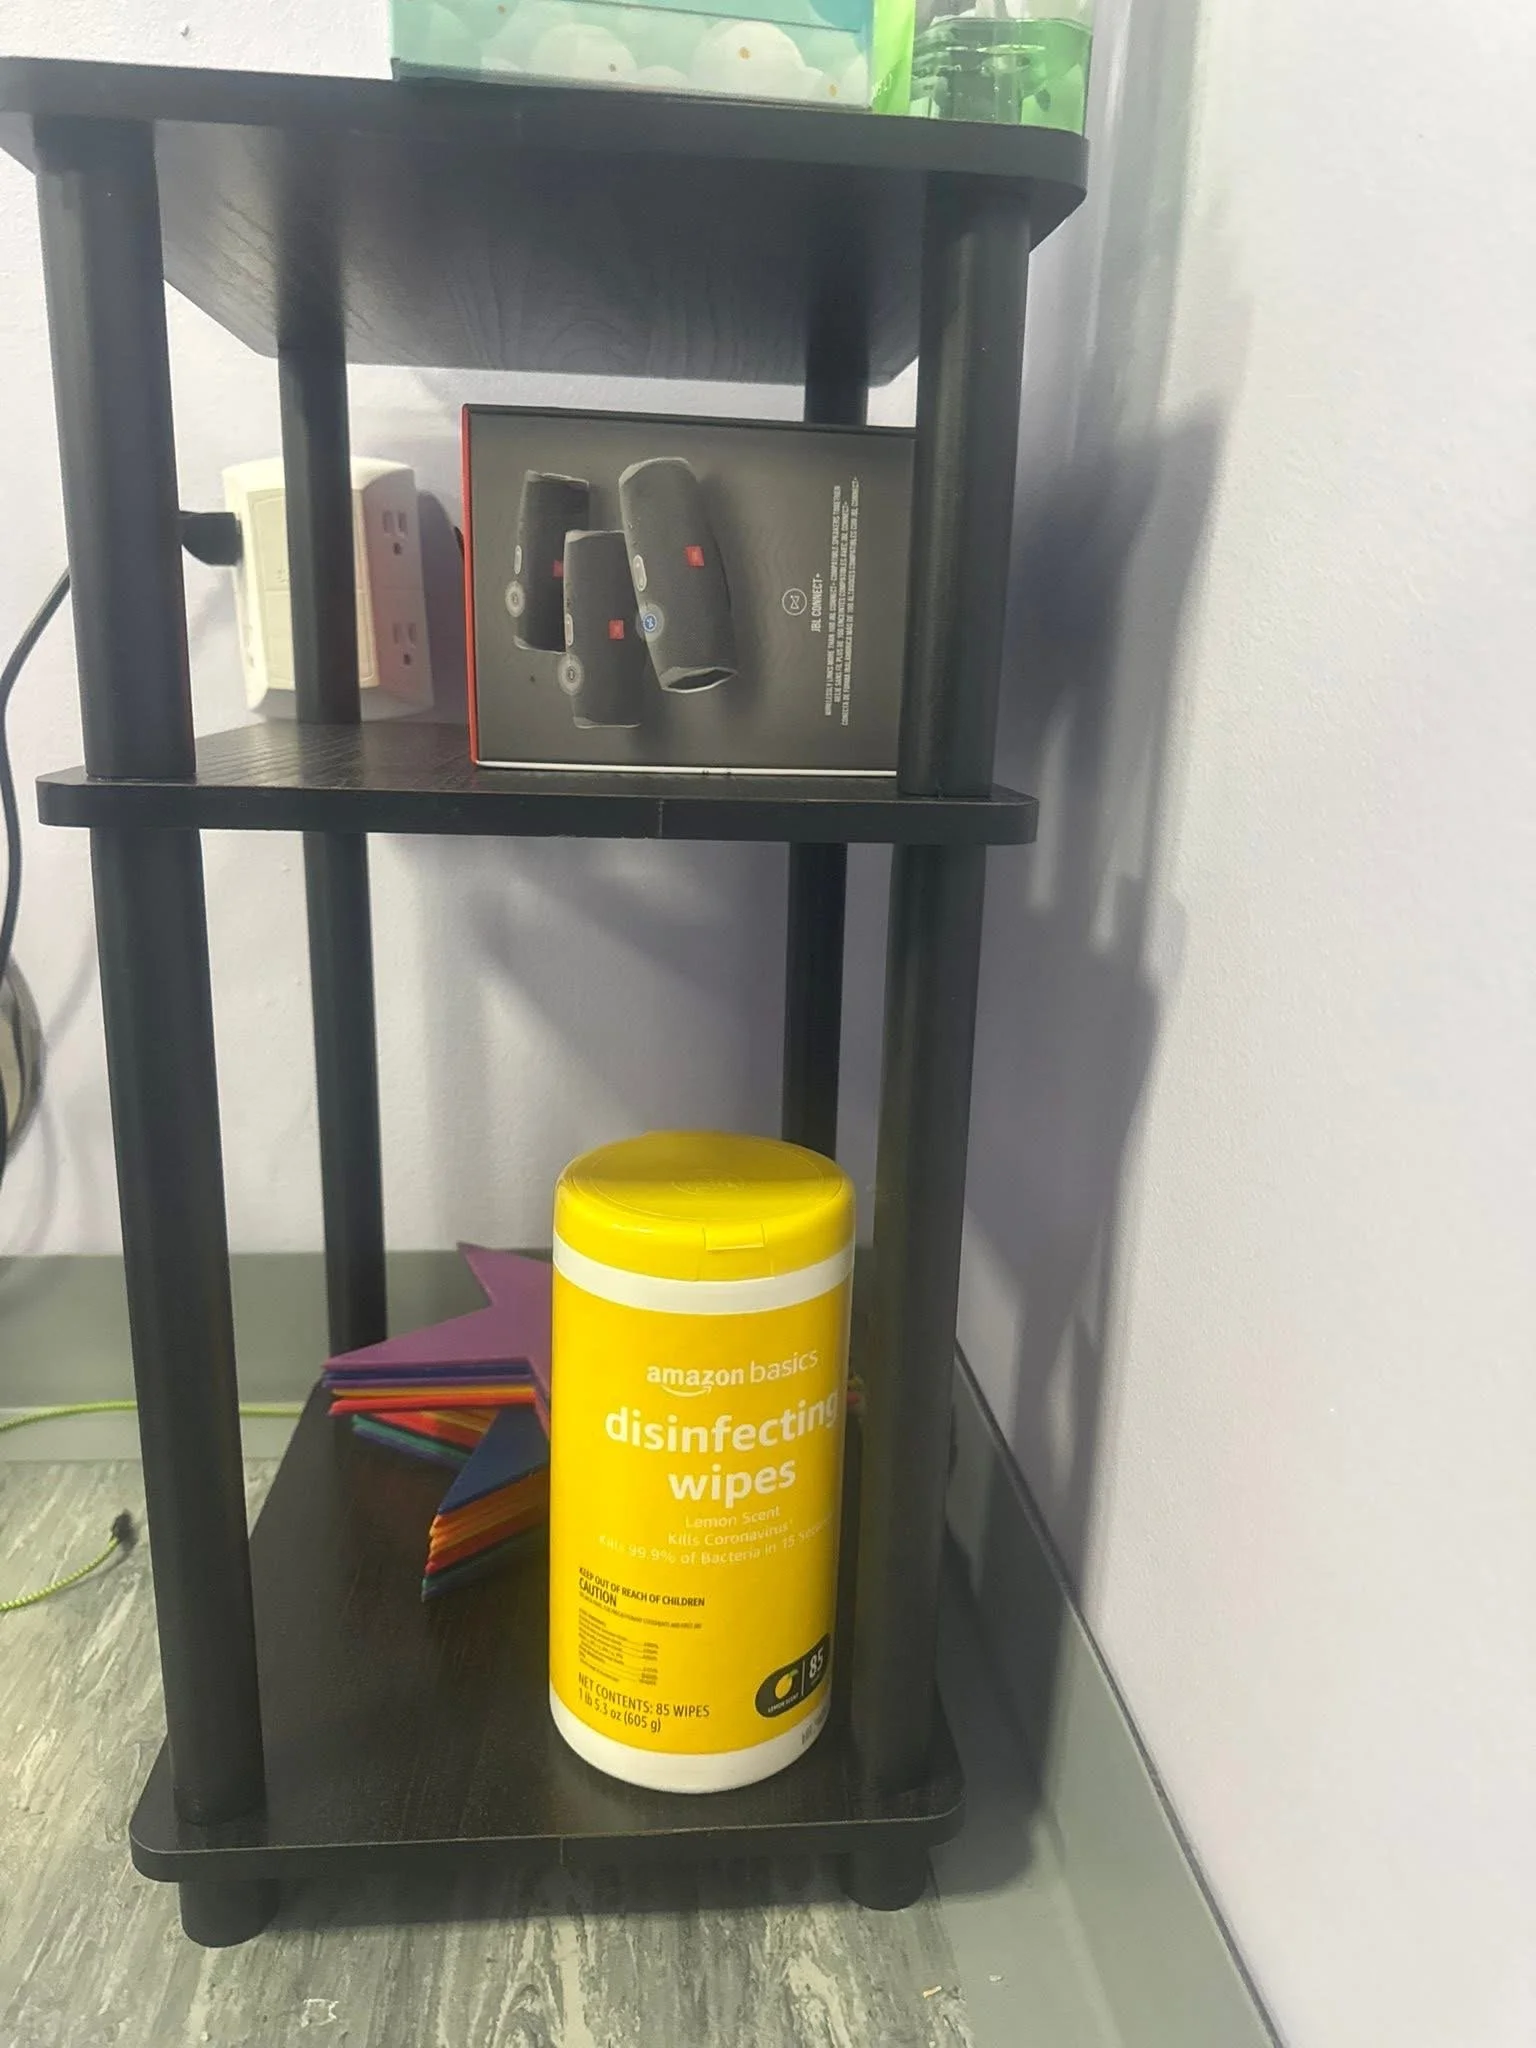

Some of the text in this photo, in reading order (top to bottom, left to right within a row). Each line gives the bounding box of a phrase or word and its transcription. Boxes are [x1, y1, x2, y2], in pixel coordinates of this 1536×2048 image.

[811, 618, 822, 633] JBL
[646, 1350, 818, 1388] amazon basics
[605, 1391, 839, 1454] disinfecting
[667, 1460, 797, 1509] wipes
[686, 1505, 781, 1529] Lemon Scent
[629, 1545, 676, 1565] 99.9%
[681, 1551, 697, 1565] of
[701, 1547, 760, 1566] Bacteria
[765, 1543, 777, 1555] in
[783, 1535, 795, 1549] 15
[668, 1531, 701, 1546] Kills
[578, 1577, 617, 1608] CAUTION
[579, 1567, 705, 1607] KEEP OUT OF REACH OF CHILDREN
[808, 1646, 824, 1679] 85
[579, 1672, 710, 1718] NET CONTENTS: 85 WIPES
[595, 1698, 609, 1716] 5.3
[611, 1709, 622, 1721] oz
[624, 1711, 649, 1729] (605
[651, 1718, 662, 1733] g)
